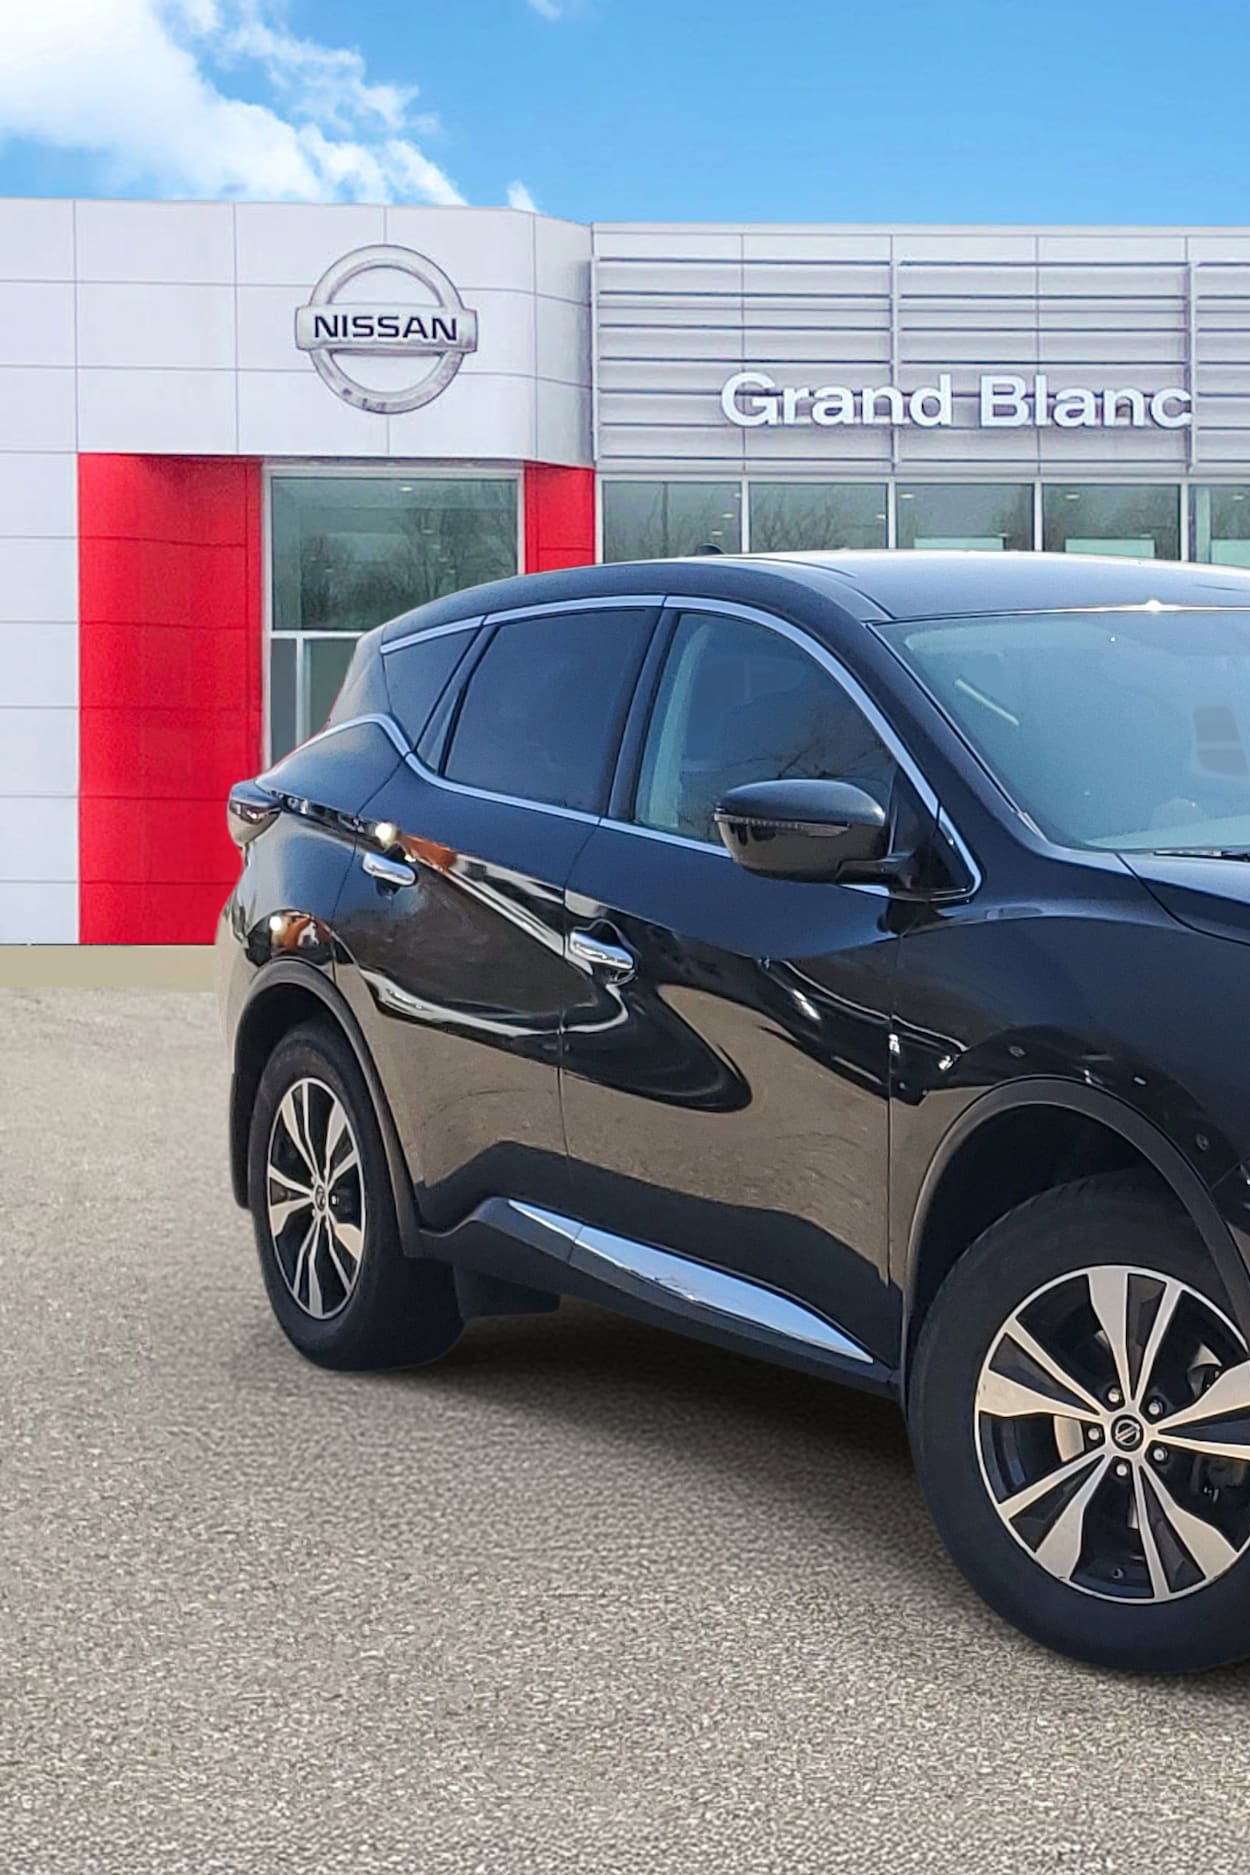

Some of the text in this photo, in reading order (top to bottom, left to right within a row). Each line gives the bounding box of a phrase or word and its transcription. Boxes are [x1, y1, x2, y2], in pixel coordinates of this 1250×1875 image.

[313, 314, 458, 341] NISSAN
[720, 372, 1193, 427] Grand Blanc
